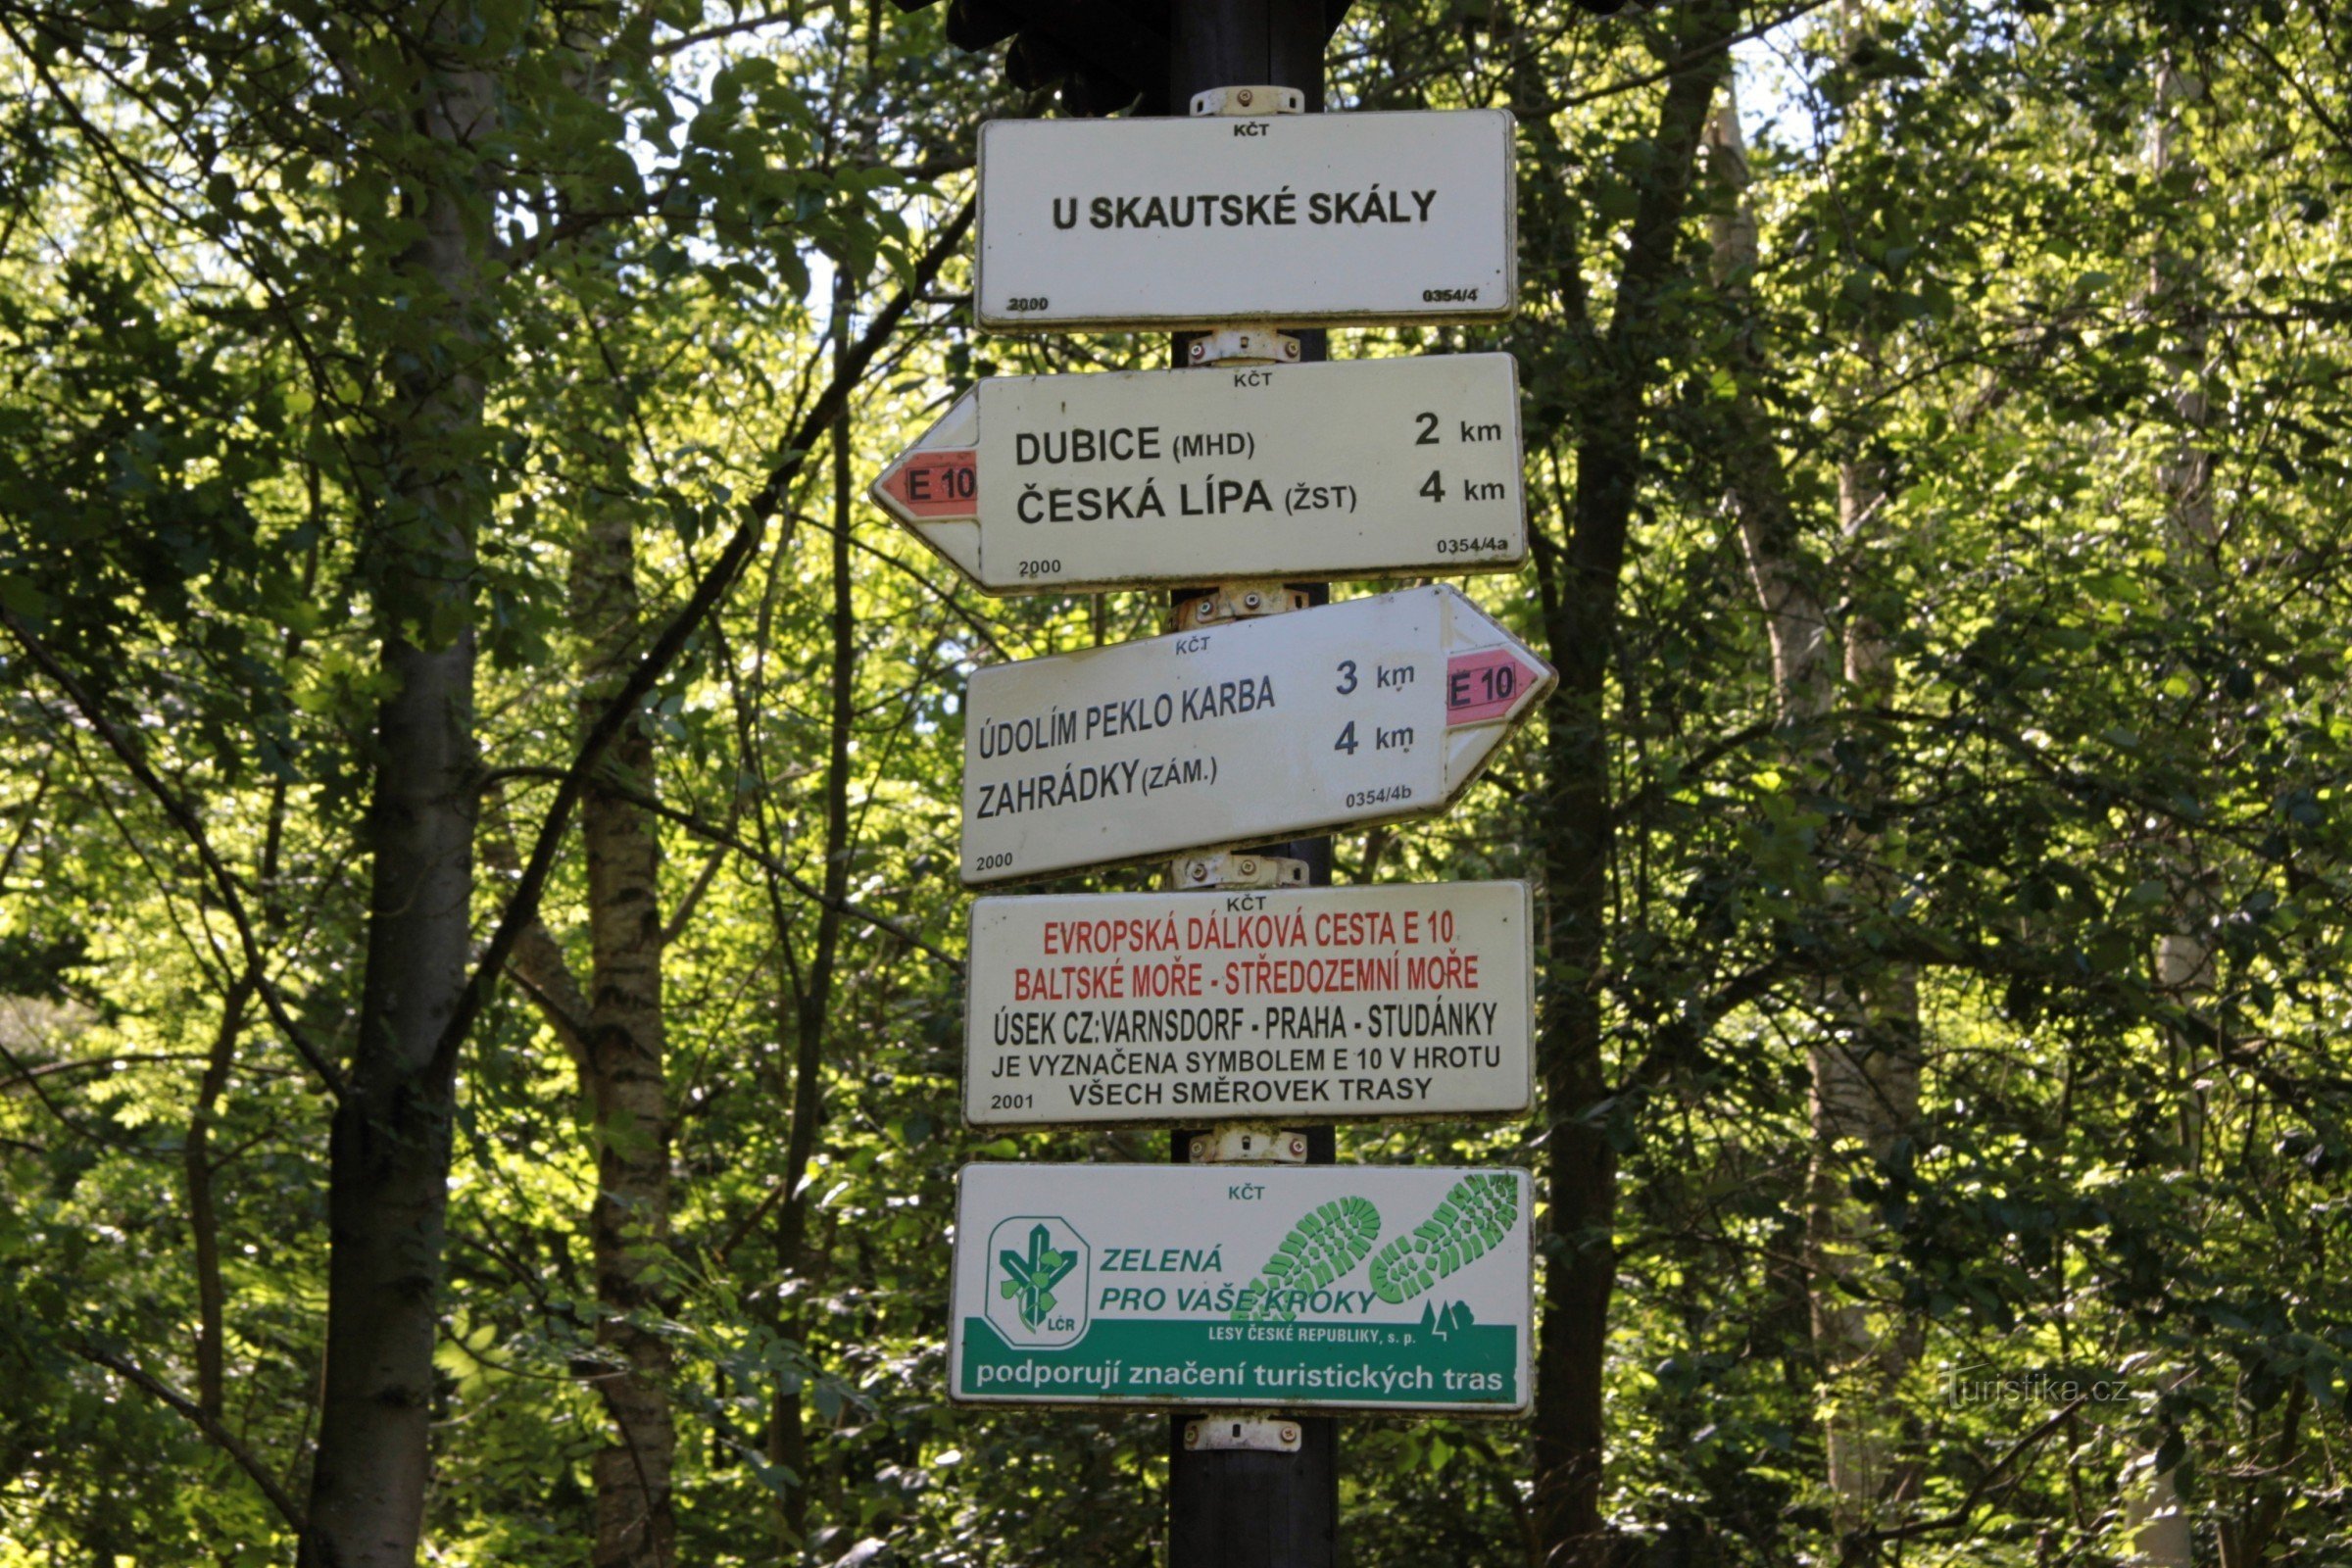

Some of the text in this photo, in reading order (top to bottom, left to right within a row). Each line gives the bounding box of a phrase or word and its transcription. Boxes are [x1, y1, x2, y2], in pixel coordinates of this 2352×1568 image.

[1233, 122, 1270, 137] KČT
[1054, 183, 1437, 228] U SKAUTSKÉ SKÁLY
[1006, 298, 1049, 311] 2000
[1423, 288, 1478, 303] 0354/4
[1234, 370, 1273, 387] KČT
[1015, 413, 1501, 466] DUBICE (MHD) 2 km
[908, 467, 975, 501] E 10
[1016, 470, 1505, 524] ČESKÁ LÍPA (ŽST) 4 km
[1437, 537, 1507, 553] 0354/4a
[1019, 560, 1060, 575] 2000
[1176, 636, 1210, 655] KČT
[1450, 667, 1513, 706] E 10
[980, 661, 1414, 760] ÚDOLÍM PEKLO KARBA 3 km
[1335, 721, 1358, 756] 4
[1376, 727, 1413, 749] km
[1346, 785, 1411, 808] 0354/4b
[976, 853, 1013, 870] 2000
[1226, 896, 1265, 912] KČT
[1044, 906, 1453, 955] EVROPSKÁ DÁLKOVÁ CESTA E 10
[1014, 958, 1124, 1001] BALTSKÉ
[1132, 956, 1202, 997] MOŘE
[1224, 951, 1399, 995] STŘEDOZEMNÍ
[1407, 949, 1479, 990] MOŘE
[994, 1006, 1056, 1046] ÚSEK
[1265, 1006, 1346, 1039] PRAHA
[1368, 997, 1497, 1037] STUDÁNKY
[992, 1046, 1500, 1078] JE VYZNAČENA SYMBOLEM E 10 V HROTU
[991, 1095, 1033, 1108] 2001
[1068, 1075, 1432, 1106] VŠECH SMĚROVEK TRASY
[1229, 1184, 1266, 1200] KČT
[1100, 1244, 1223, 1272] ZELENÁ
[1100, 1284, 1377, 1313] PRO VAŠE KROKY
[1047, 1315, 1074, 1331] LČR
[1208, 1327, 1245, 1341] LESY
[1247, 1323, 1295, 1341] ČESKÉ
[1298, 1327, 1384, 1345] REPUBLIKY,
[976, 1358, 1503, 1392] podporují značení turistických tras
